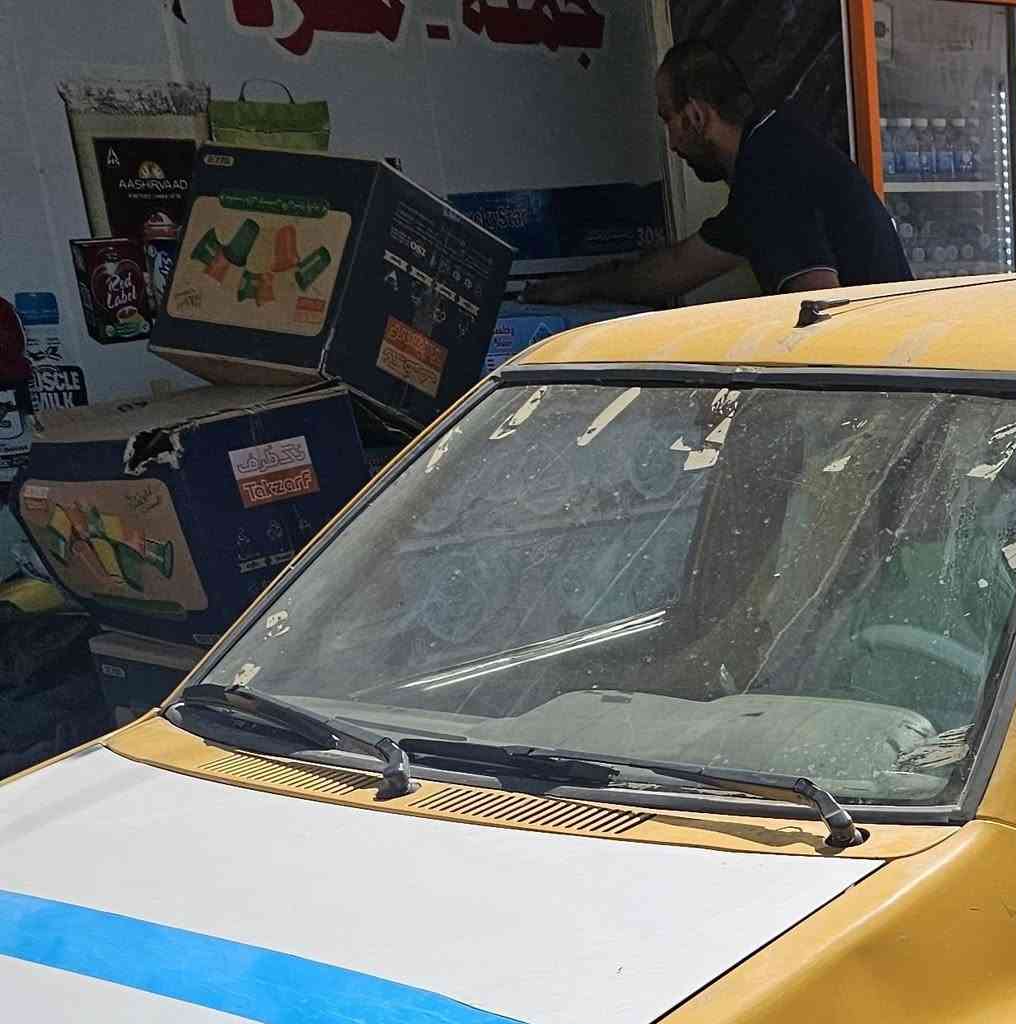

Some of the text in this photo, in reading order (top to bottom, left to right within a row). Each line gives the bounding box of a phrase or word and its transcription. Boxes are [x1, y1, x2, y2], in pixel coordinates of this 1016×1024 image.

[108, 272, 132, 292] Red
[106, 287, 136, 310] Label
[243, 468, 312, 502] Takzarf
